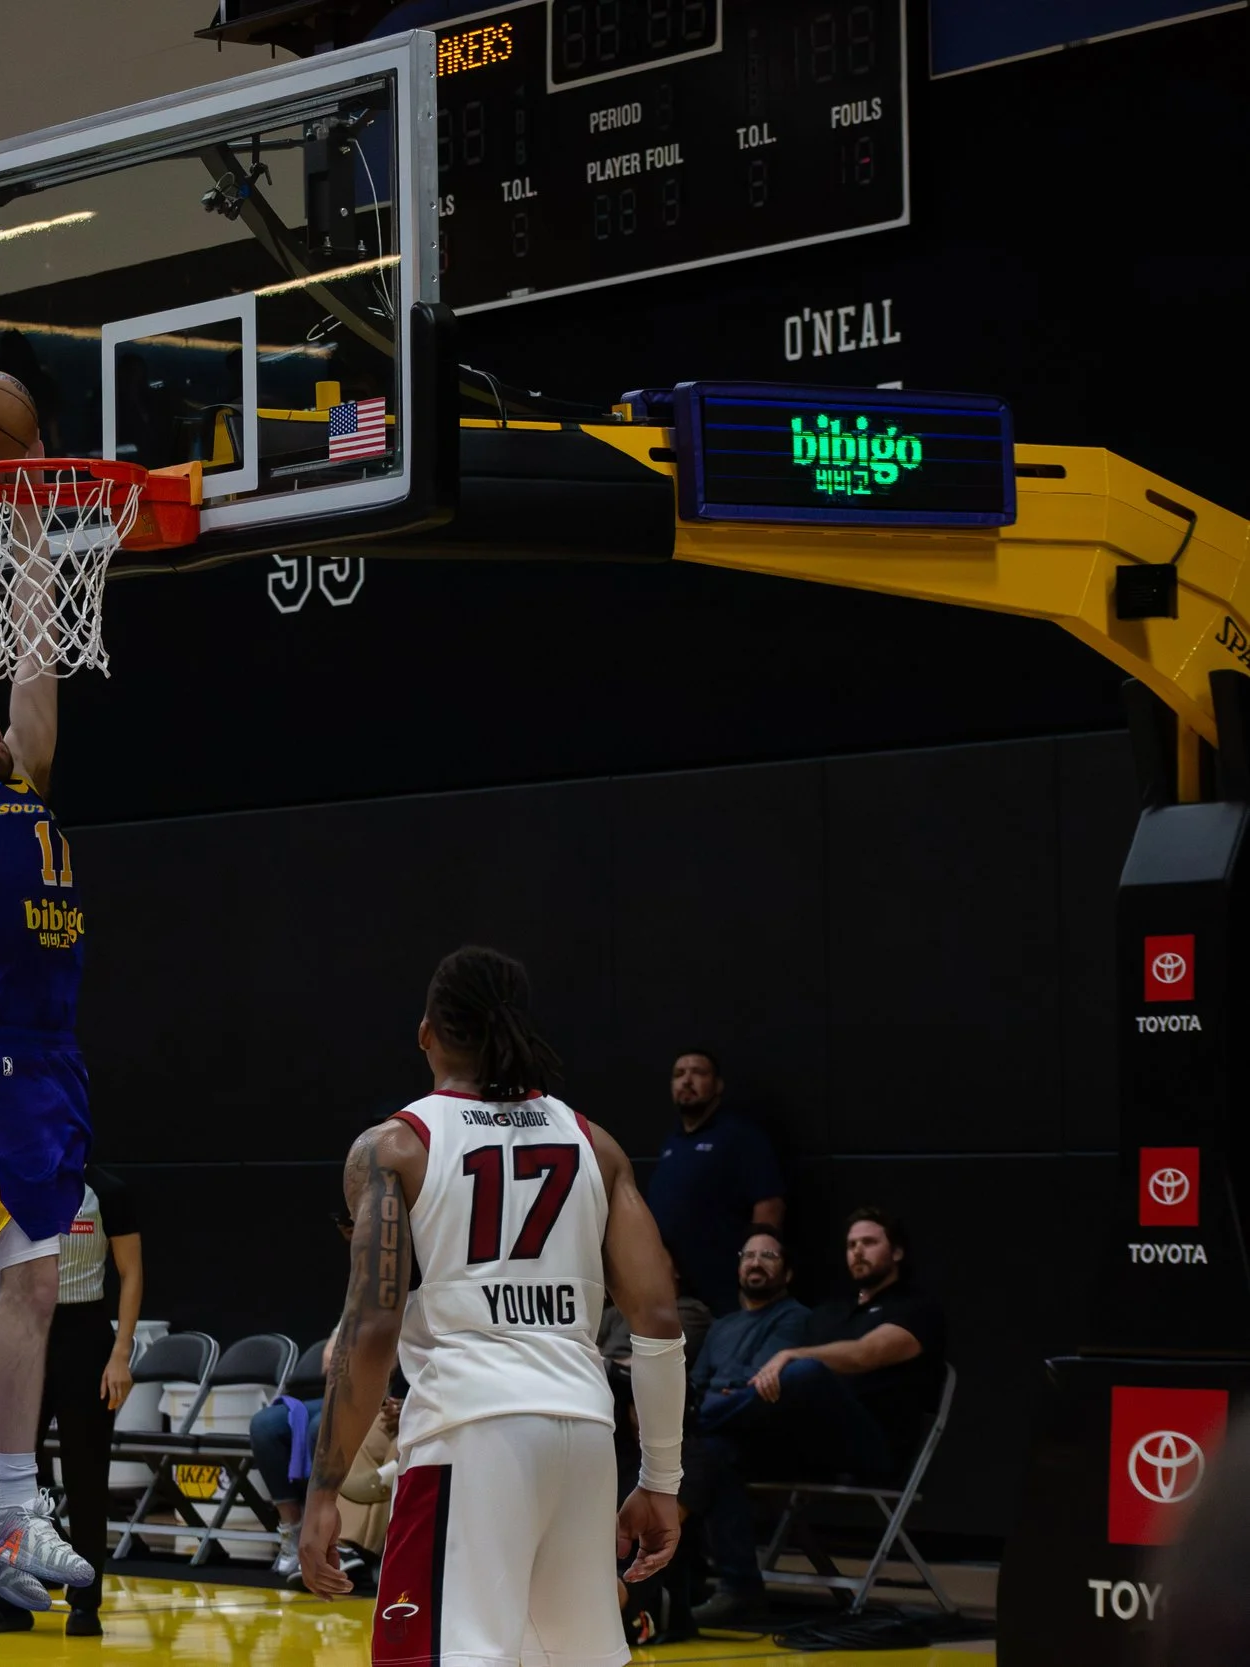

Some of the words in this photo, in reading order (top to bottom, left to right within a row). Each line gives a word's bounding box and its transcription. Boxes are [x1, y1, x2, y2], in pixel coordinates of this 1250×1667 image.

[438, 21, 513, 77] AKERS
[589, 102, 642, 134] PERIOD
[830, 97, 882, 129] FOULS
[736, 122, 777, 150] T.O.L.
[586, 152, 641, 184] PLAYER
[645, 143, 684, 170] FOUL
[501, 176, 538, 202] T.O.L.
[784, 298, 902, 362] O'NEAL
[790, 412, 923, 485] bibigo
[815, 469, 873, 495] 비비고
[34, 820, 74, 888] 11
[24, 898, 85, 943] bibigo
[1135, 1014, 1202, 1033] TOYOTA
[470, 1109, 495, 1127] NBA
[510, 1111, 550, 1128] LEAGUE
[463, 1143, 580, 1265] 17
[1127, 1242, 1209, 1264] TOYOTA
[482, 1284, 576, 1326] YOUNG
